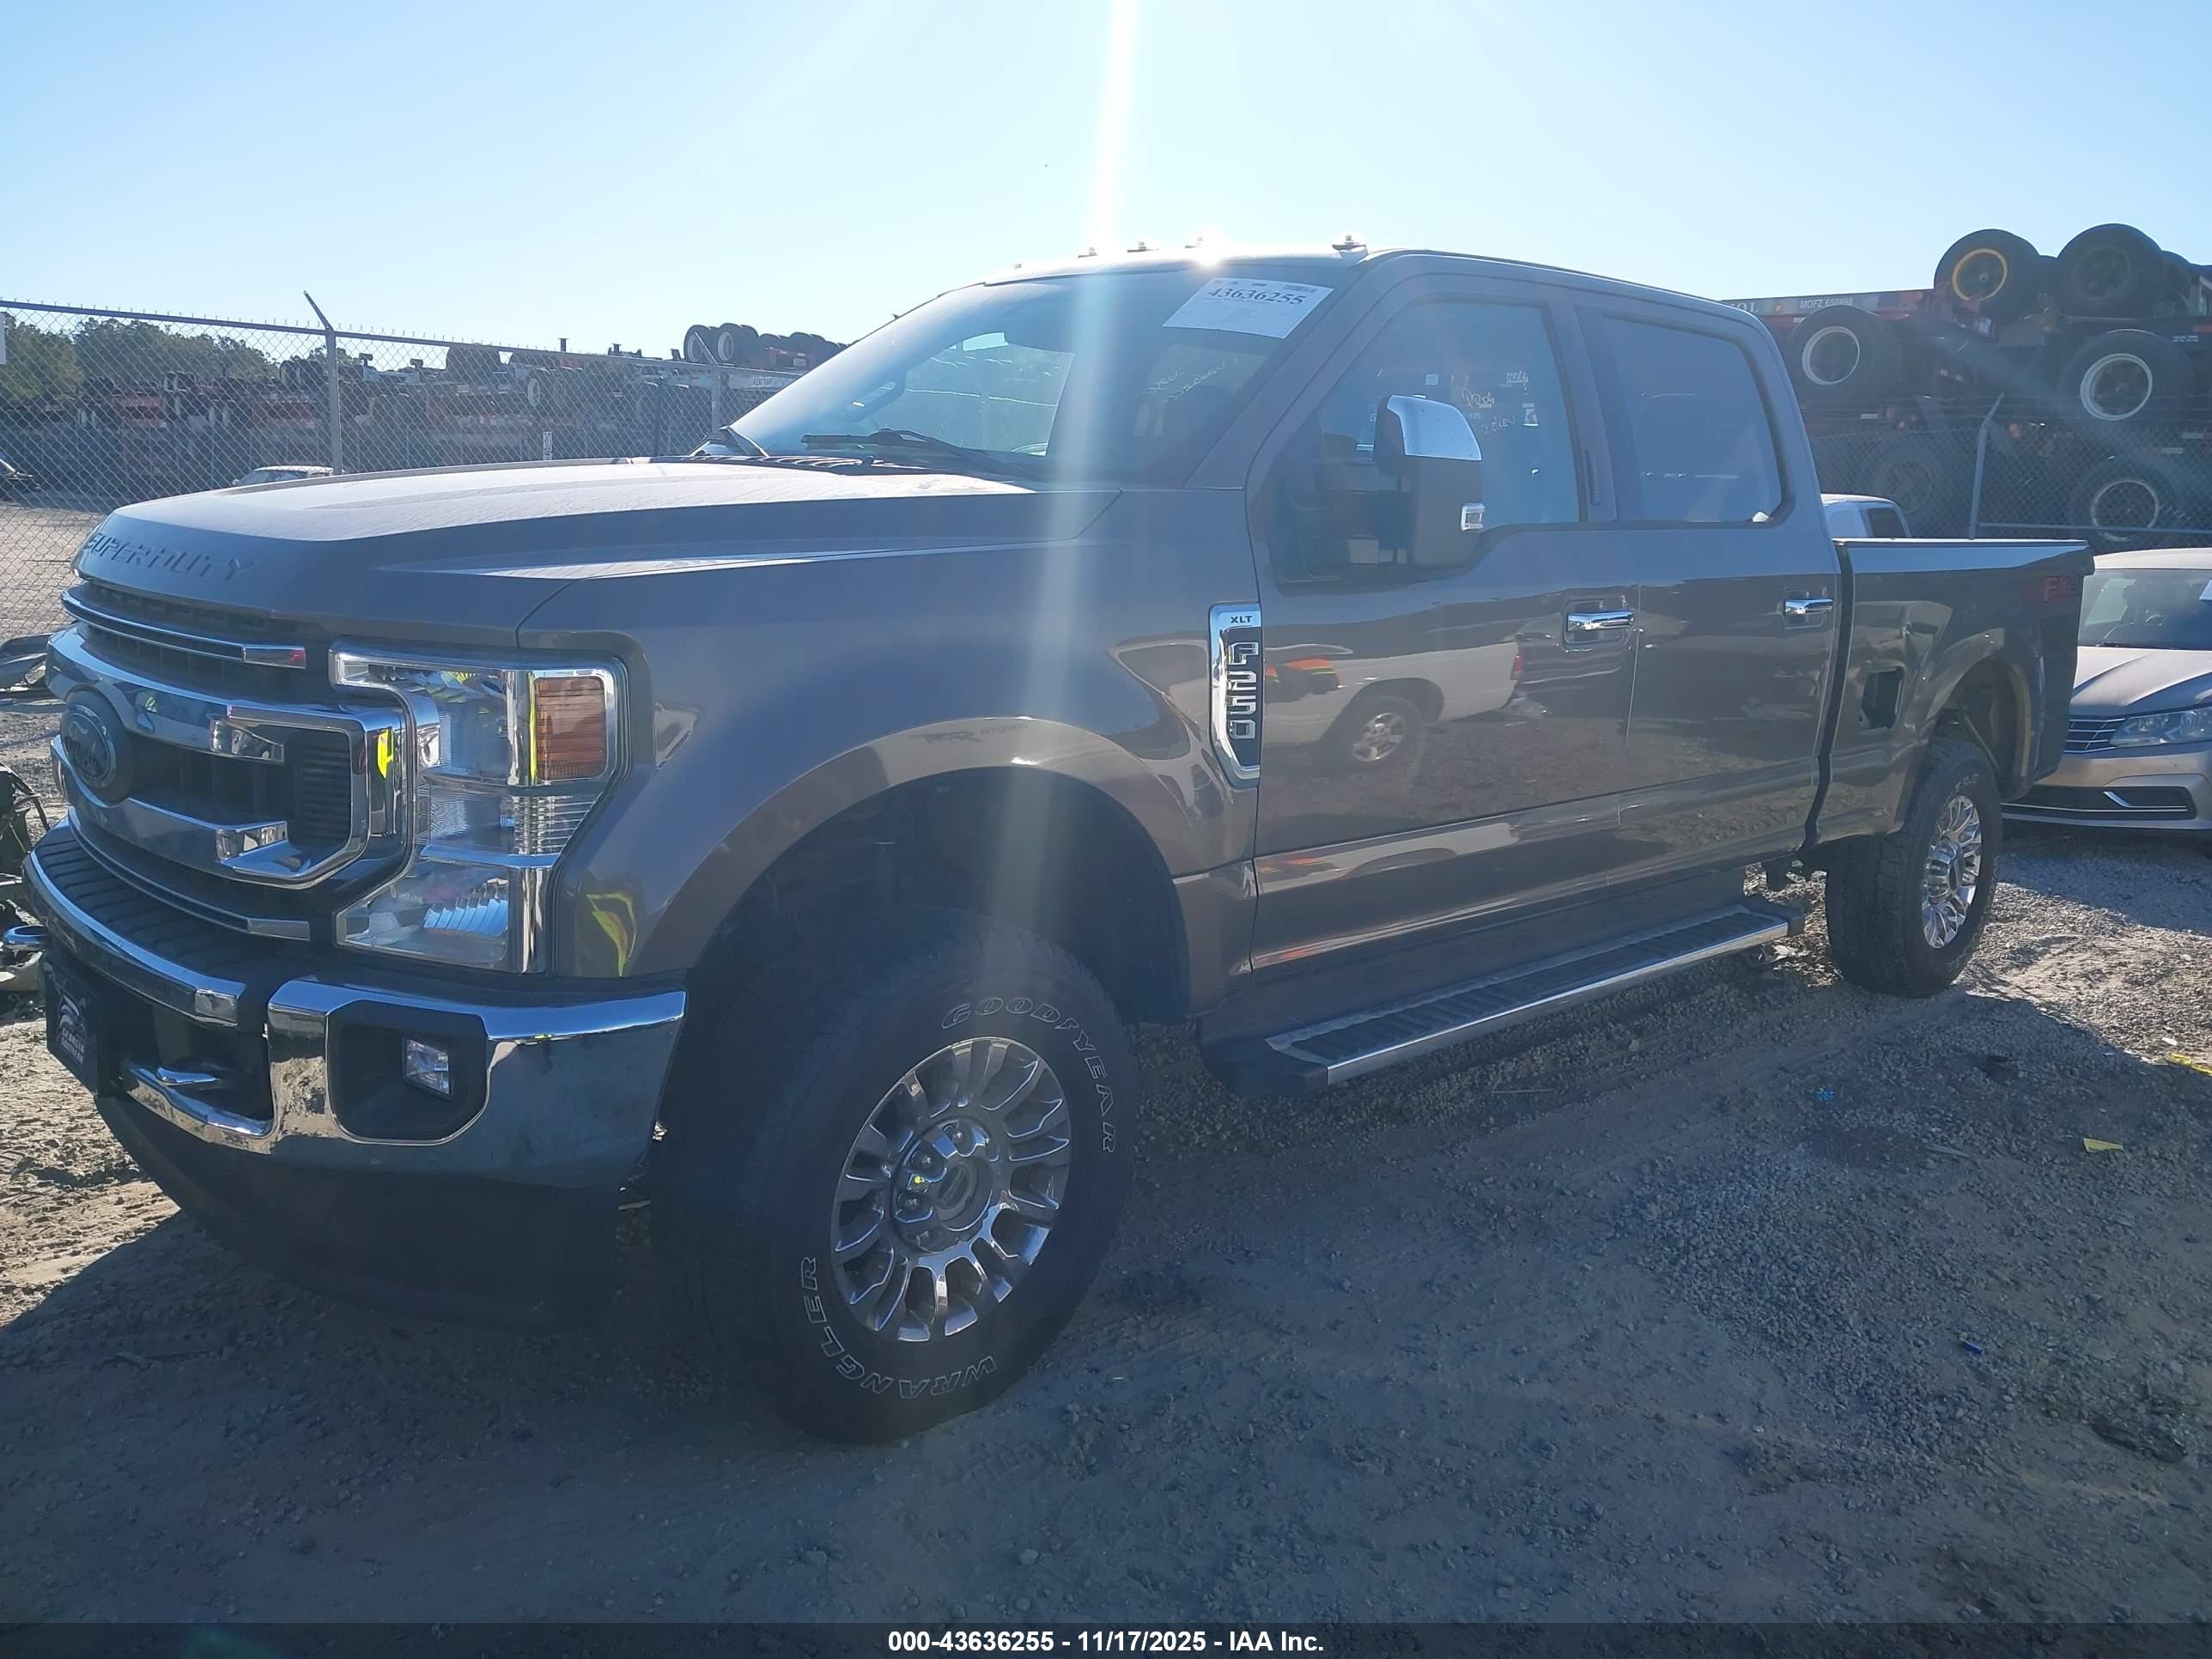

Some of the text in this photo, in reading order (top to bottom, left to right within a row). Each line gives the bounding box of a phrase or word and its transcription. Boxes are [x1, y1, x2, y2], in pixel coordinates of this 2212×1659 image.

[1207, 288, 1307, 306] 43636255
[942, 997, 1115, 1153] GOODYEAR
[801, 1256, 997, 1399] WRANGLER
